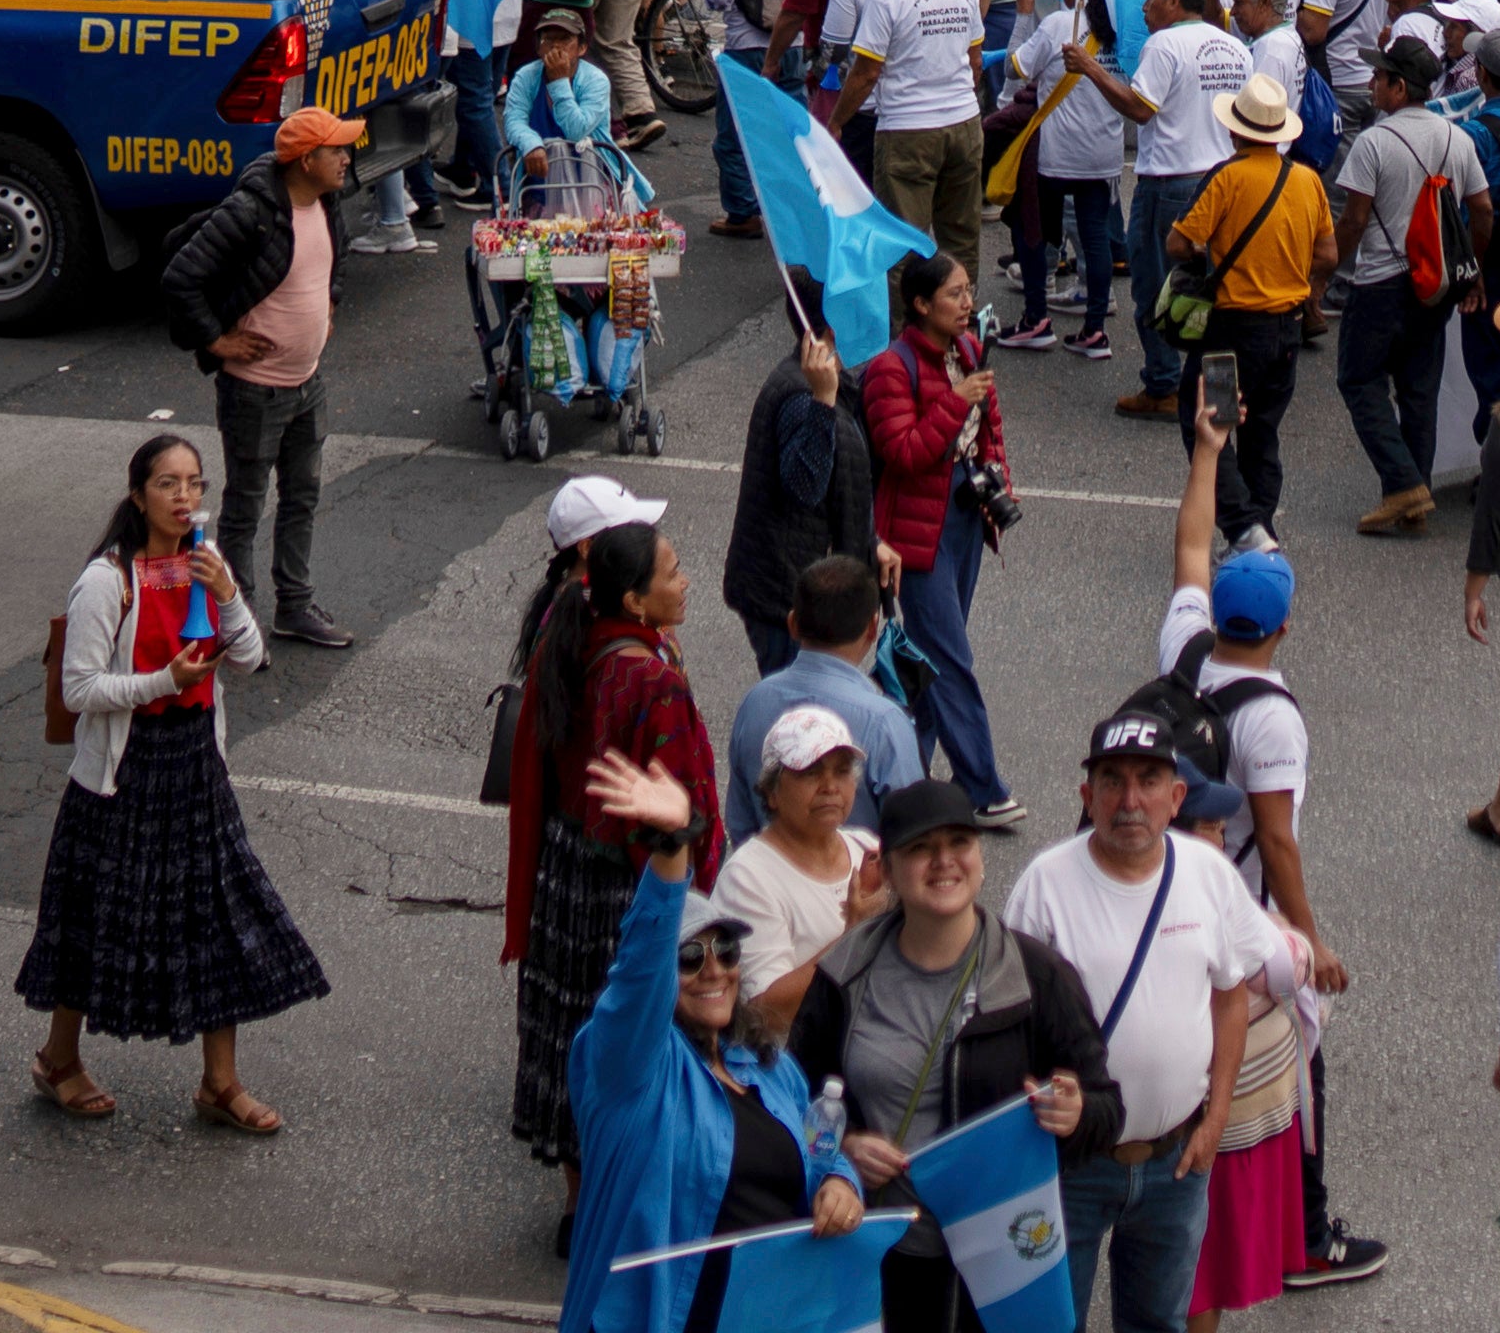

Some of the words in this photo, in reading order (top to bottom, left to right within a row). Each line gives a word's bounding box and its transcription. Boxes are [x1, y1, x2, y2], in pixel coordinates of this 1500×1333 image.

[920, 7, 960, 18] SINDICATO
[79, 17, 240, 57] DIFEP
[314, 12, 432, 118] DIFEP-083
[1200, 62, 1234, 71] SINDICATO
[1198, 72, 1247, 82] TRABAJADORES
[1200, 82, 1242, 91] MUNICIPALES
[107, 135, 234, 177] DIFEP-083
[1102, 724, 1158, 750] UFC
